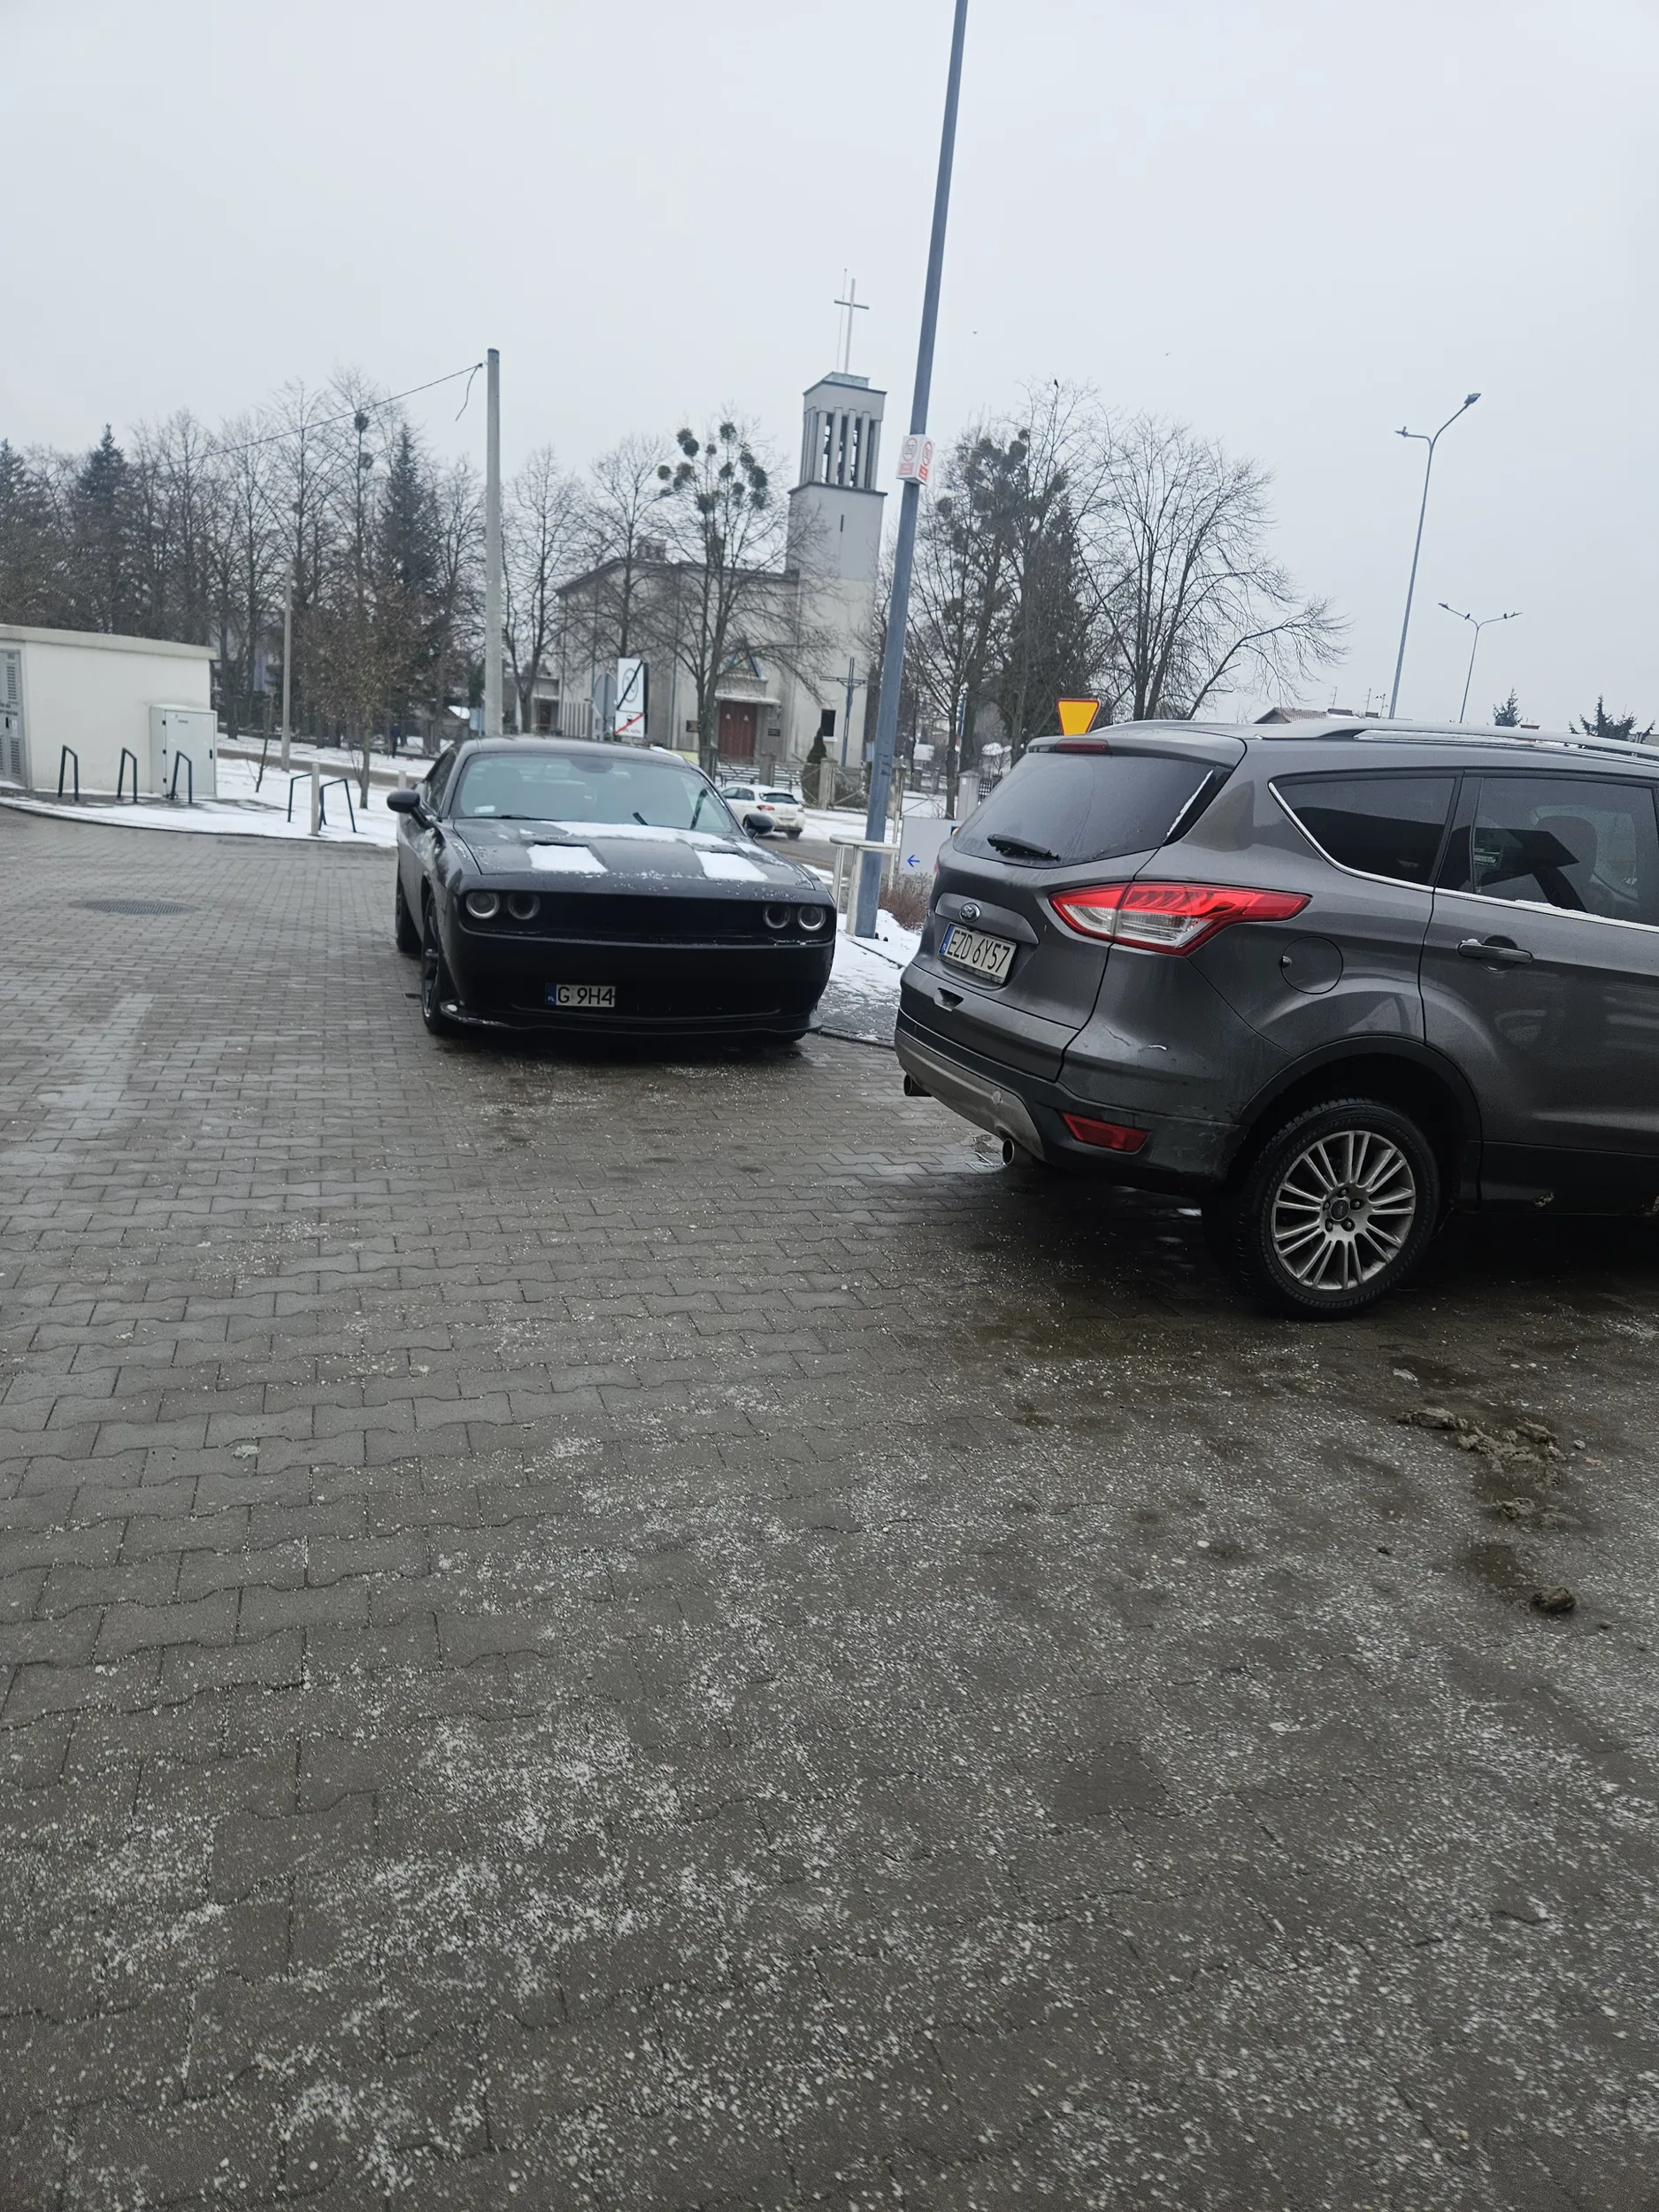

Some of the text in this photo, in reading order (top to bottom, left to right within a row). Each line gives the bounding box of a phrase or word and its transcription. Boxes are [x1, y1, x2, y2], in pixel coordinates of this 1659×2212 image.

[947, 931, 1010, 972] EZD 6Y57
[558, 987, 613, 1005] G 9H4
